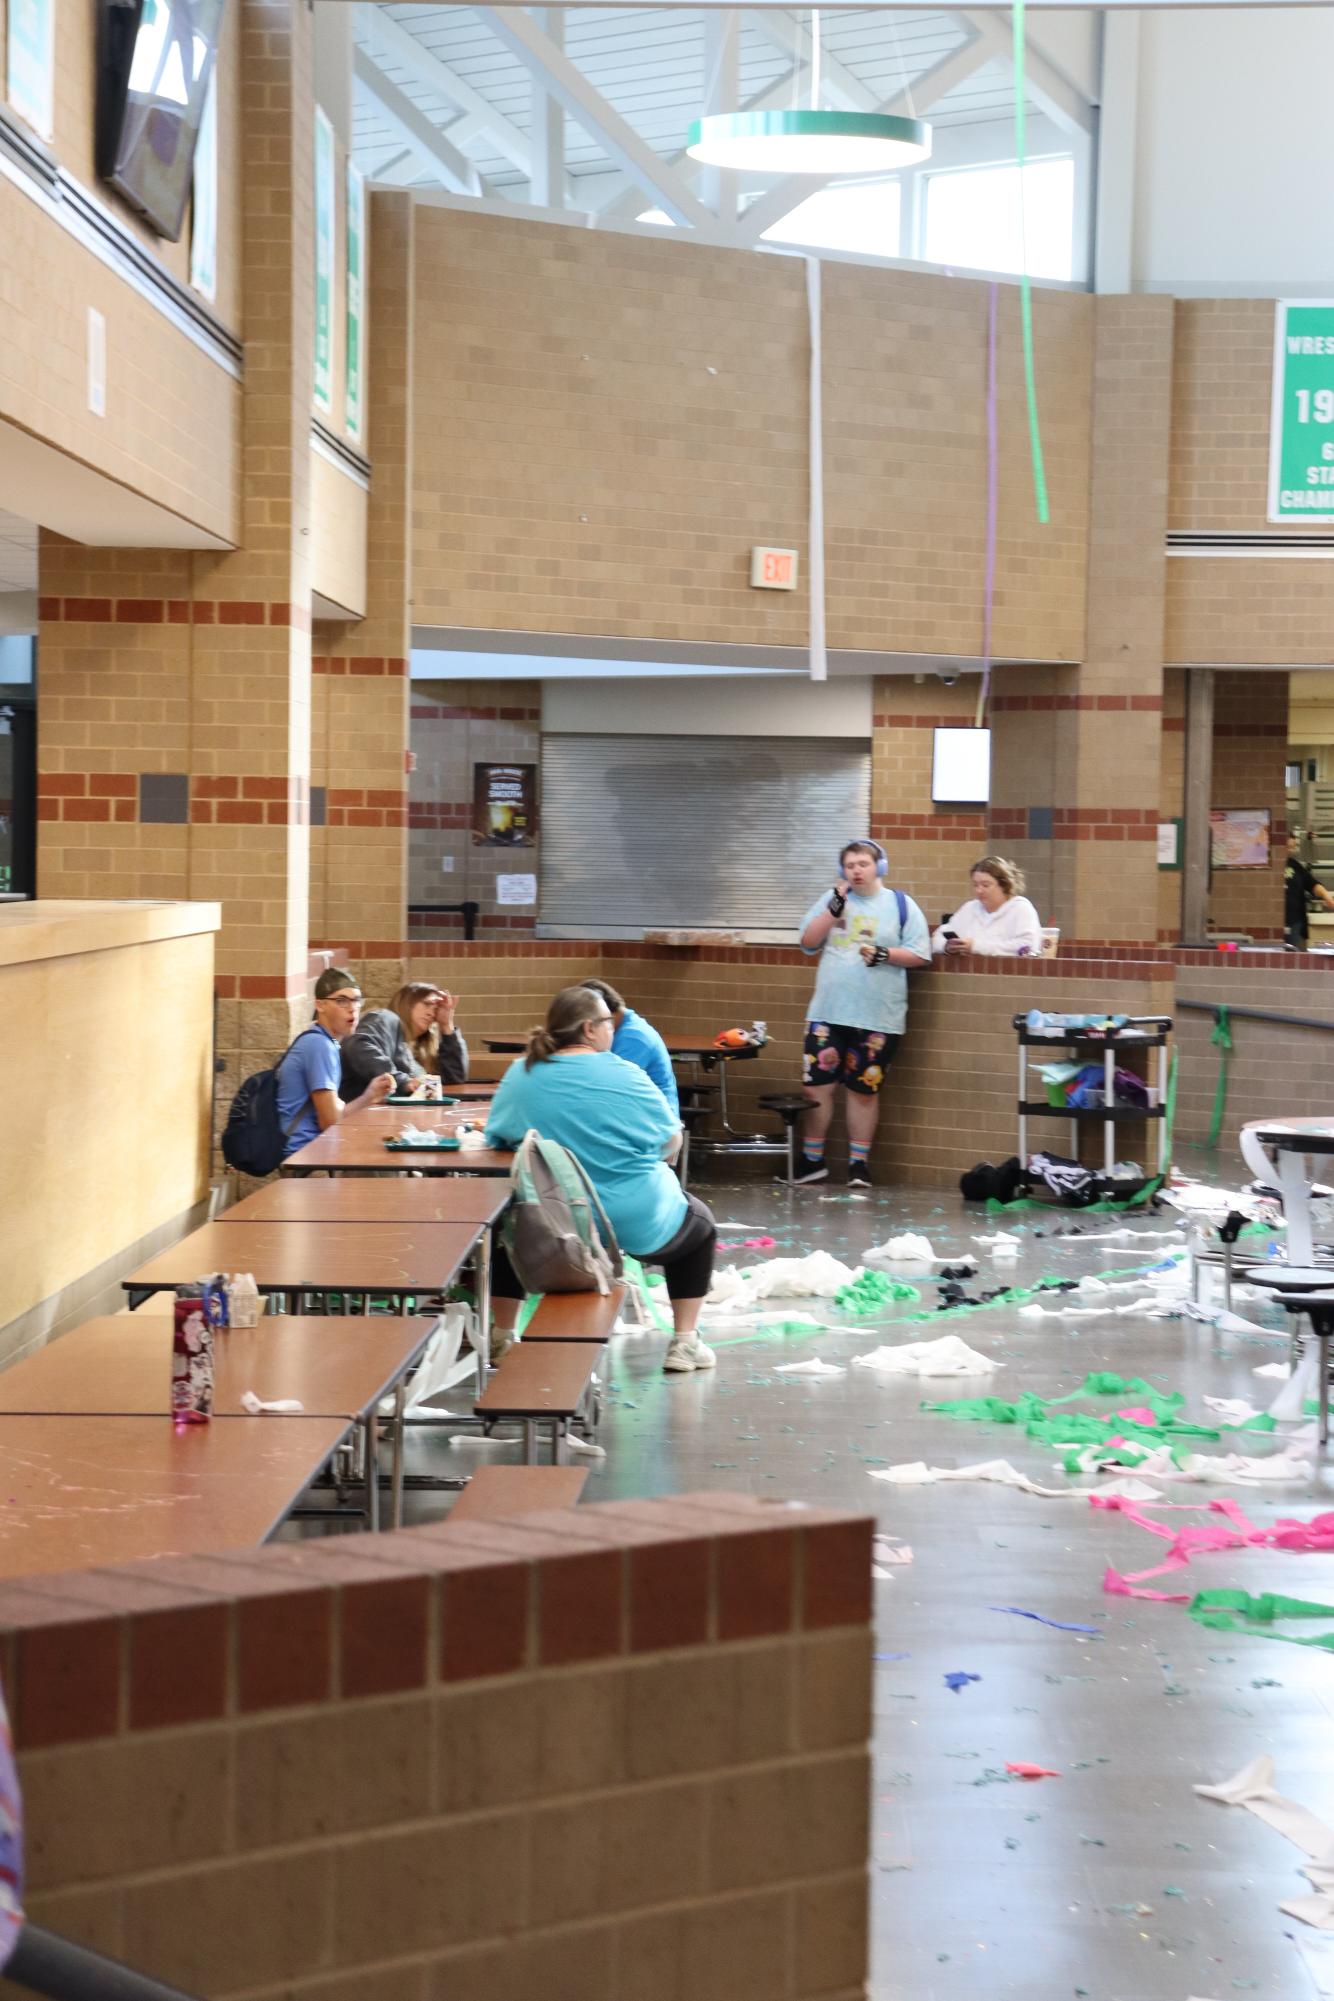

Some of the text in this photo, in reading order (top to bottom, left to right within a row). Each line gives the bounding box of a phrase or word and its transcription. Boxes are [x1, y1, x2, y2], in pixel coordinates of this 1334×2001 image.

[1287, 336, 1334, 354] WRES
[1295, 389, 1334, 424] 19
[763, 552, 792, 583] EXIT
